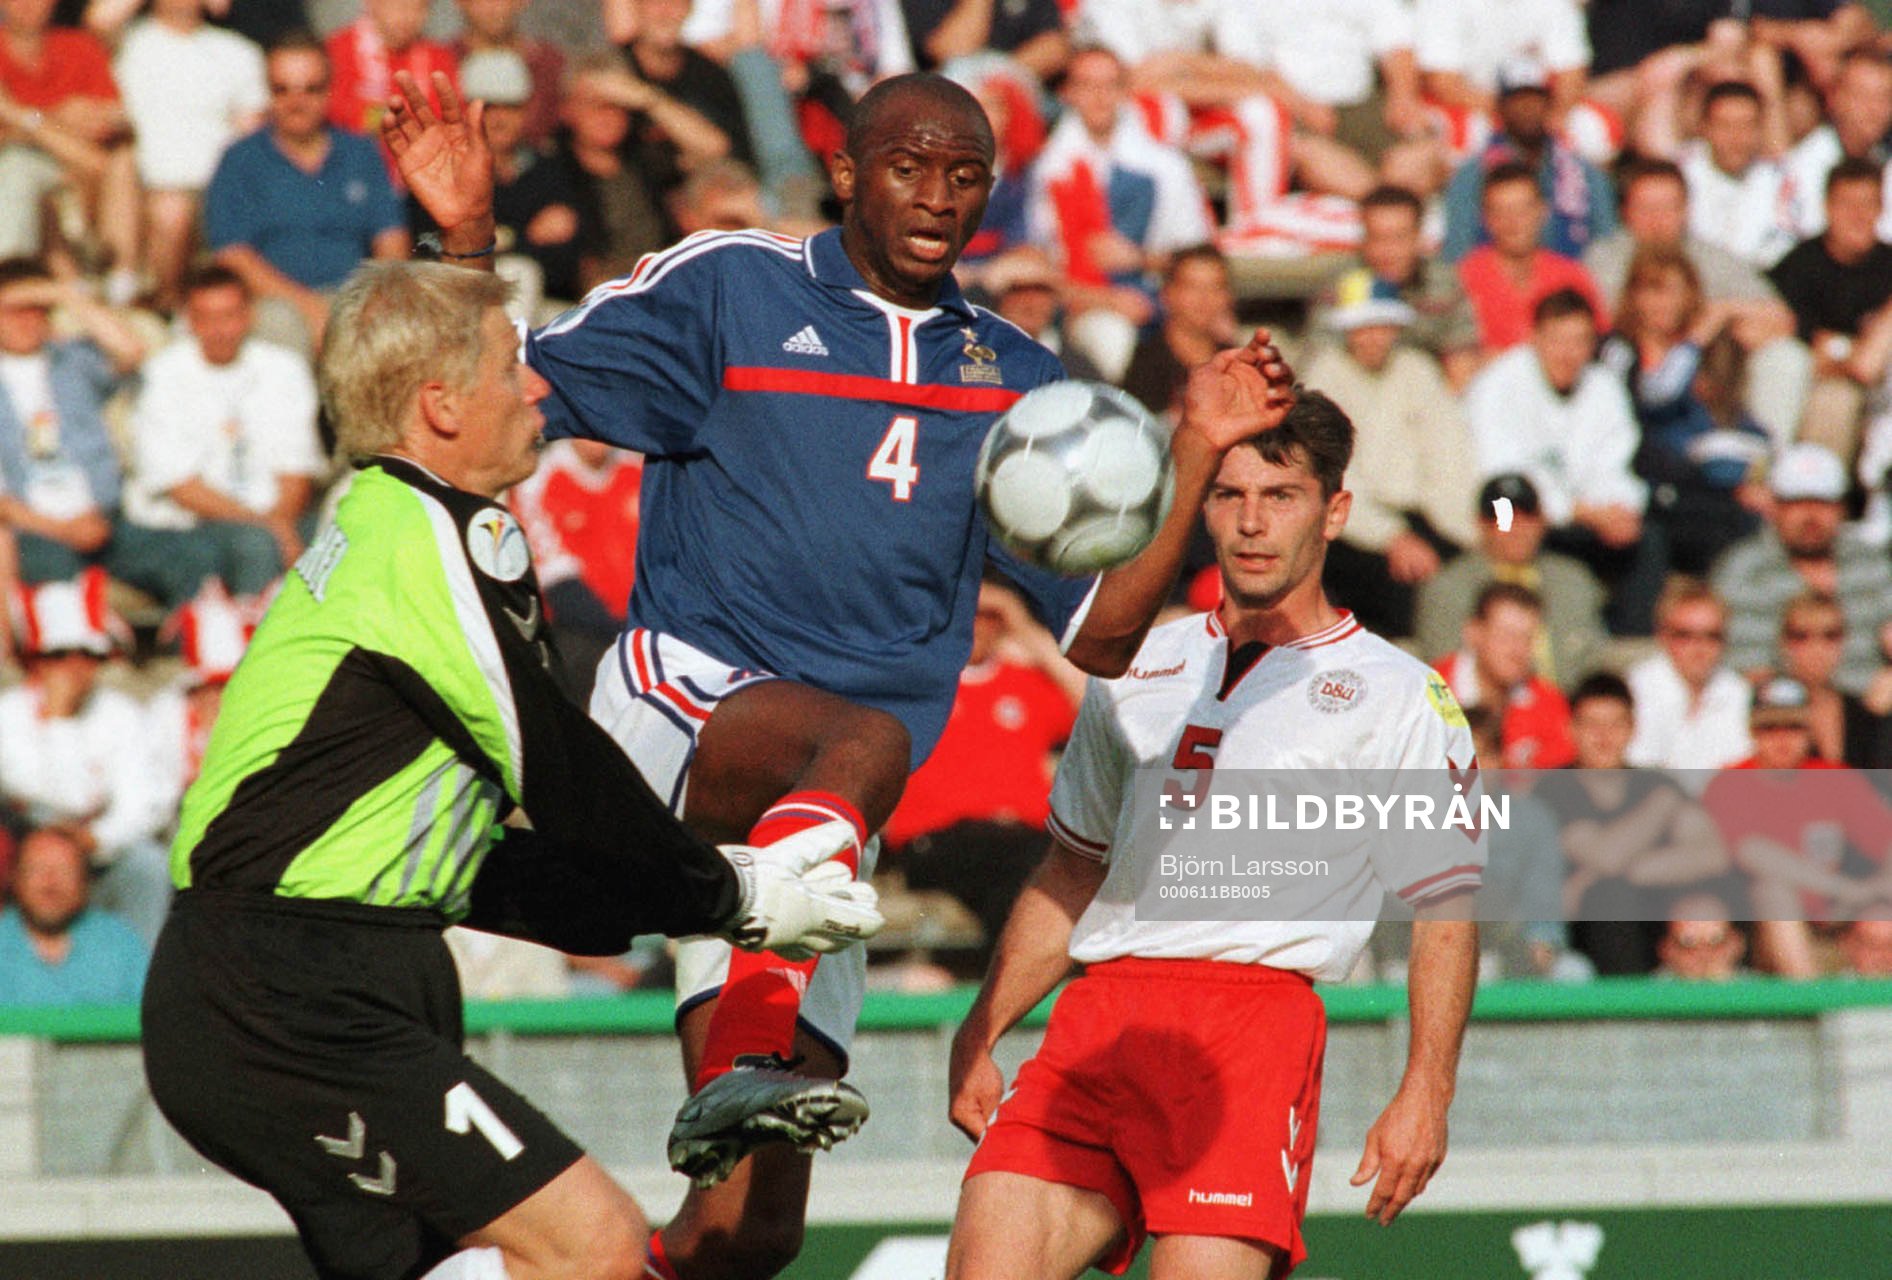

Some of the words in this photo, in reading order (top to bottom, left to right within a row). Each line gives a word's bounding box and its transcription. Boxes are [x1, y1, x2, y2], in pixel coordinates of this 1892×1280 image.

[782, 341, 829, 357] adidas
[866, 414, 920, 502] 4
[1163, 724, 1223, 812] 5
[445, 1081, 525, 1161] 1
[1188, 1188, 1253, 1208] hummel
